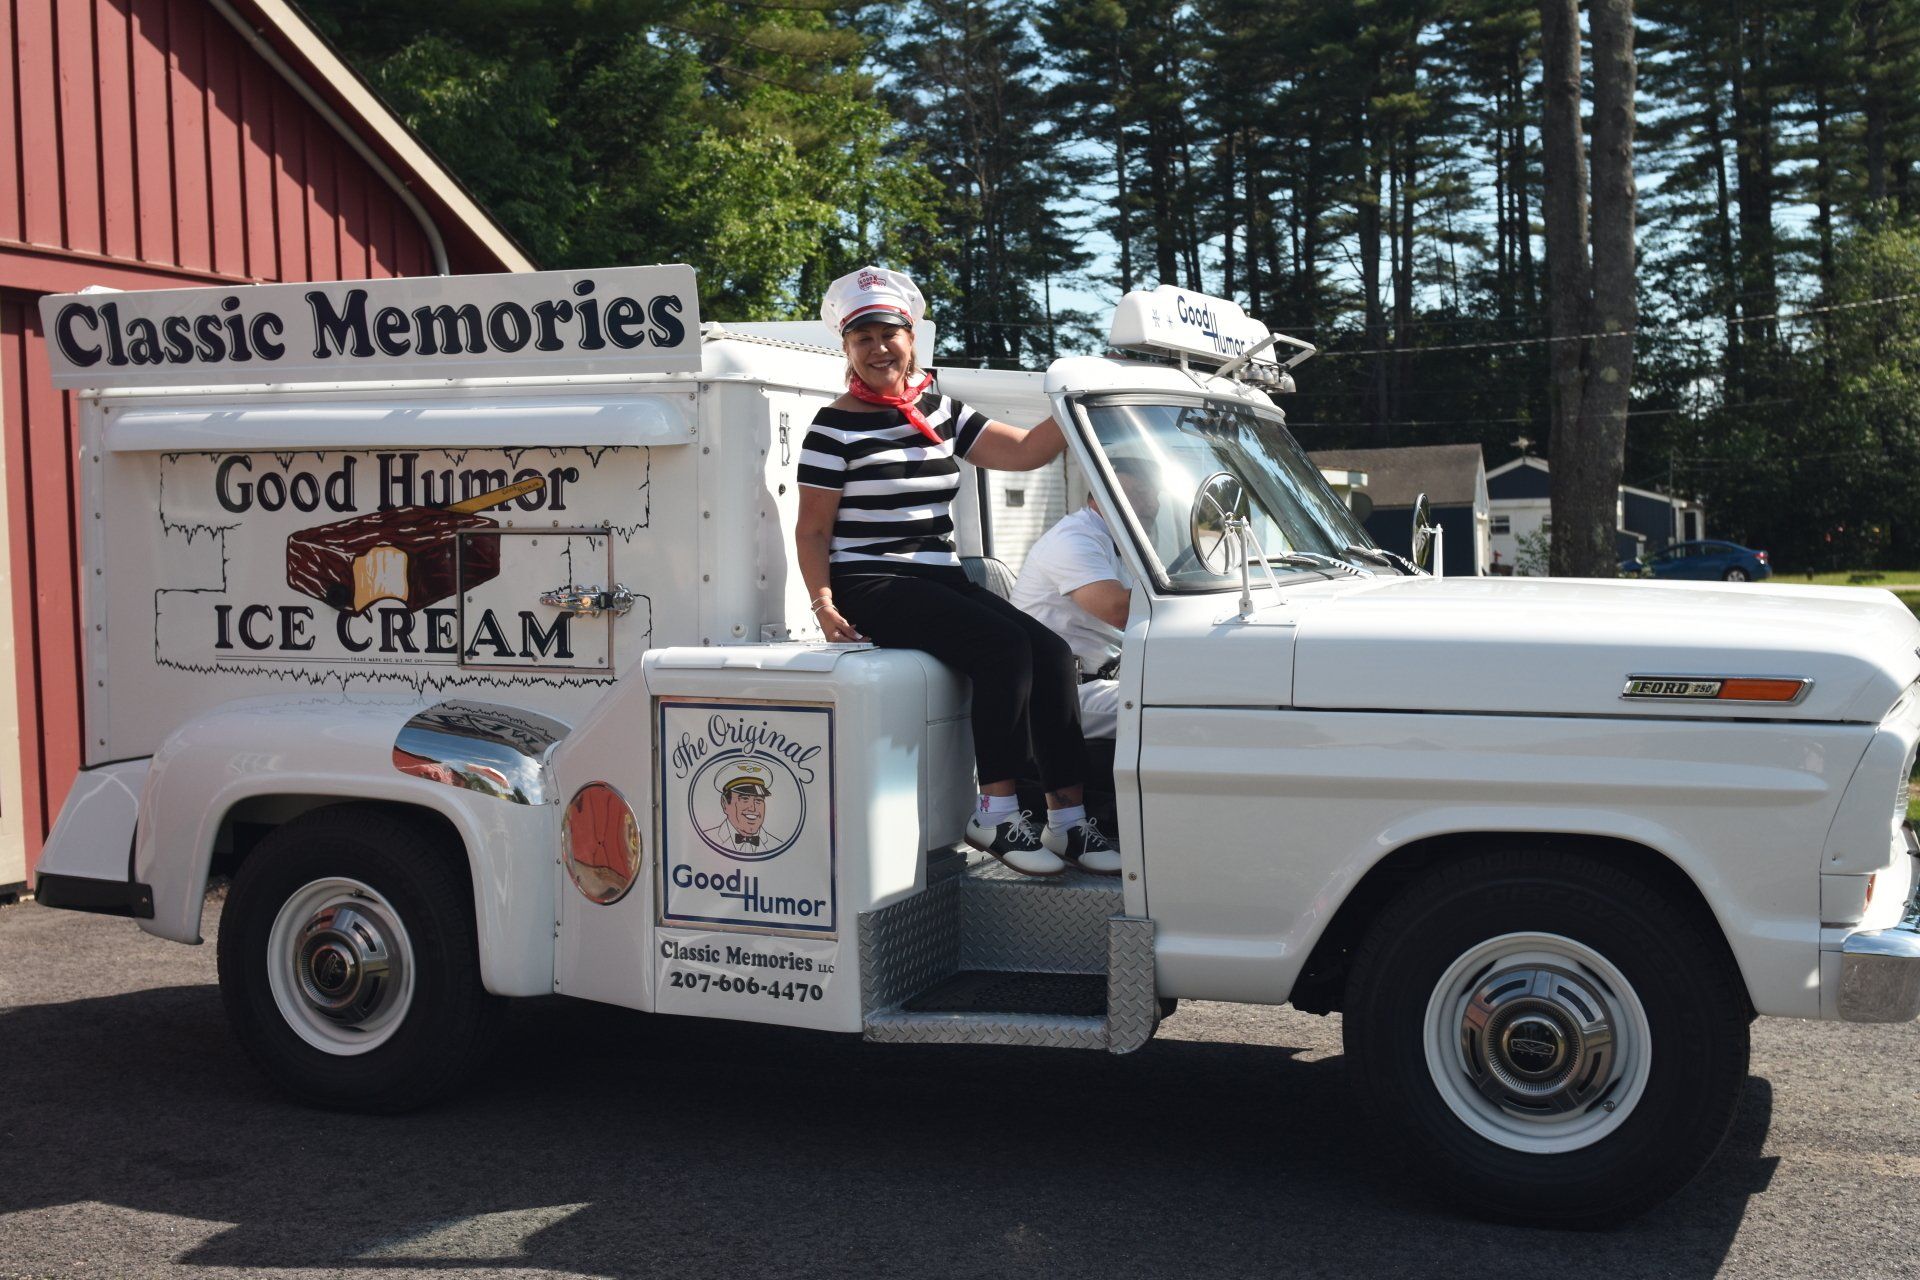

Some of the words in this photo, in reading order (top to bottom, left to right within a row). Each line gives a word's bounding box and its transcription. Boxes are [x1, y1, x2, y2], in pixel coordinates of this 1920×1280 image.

[54, 296, 286, 367] Classic
[305, 280, 686, 359] Memories
[1177, 295, 1210, 329] Good
[1203, 312, 1246, 356] Humor
[215, 454, 358, 513] Good
[377, 453, 579, 513] Humor
[215, 604, 315, 652] ICE
[337, 603, 575, 660] CREAM
[1638, 681, 1689, 695] FORD
[1693, 684, 1712, 693] 250
[672, 731, 708, 779] The
[708, 714, 822, 785] Original
[672, 864, 741, 892] Good
[720, 876, 826, 916] Humor
[660, 940, 720, 963] Classic
[726, 945, 813, 972] Memories
[818, 963, 835, 974] LLC
[670, 971, 824, 1002] 207-606-4470
